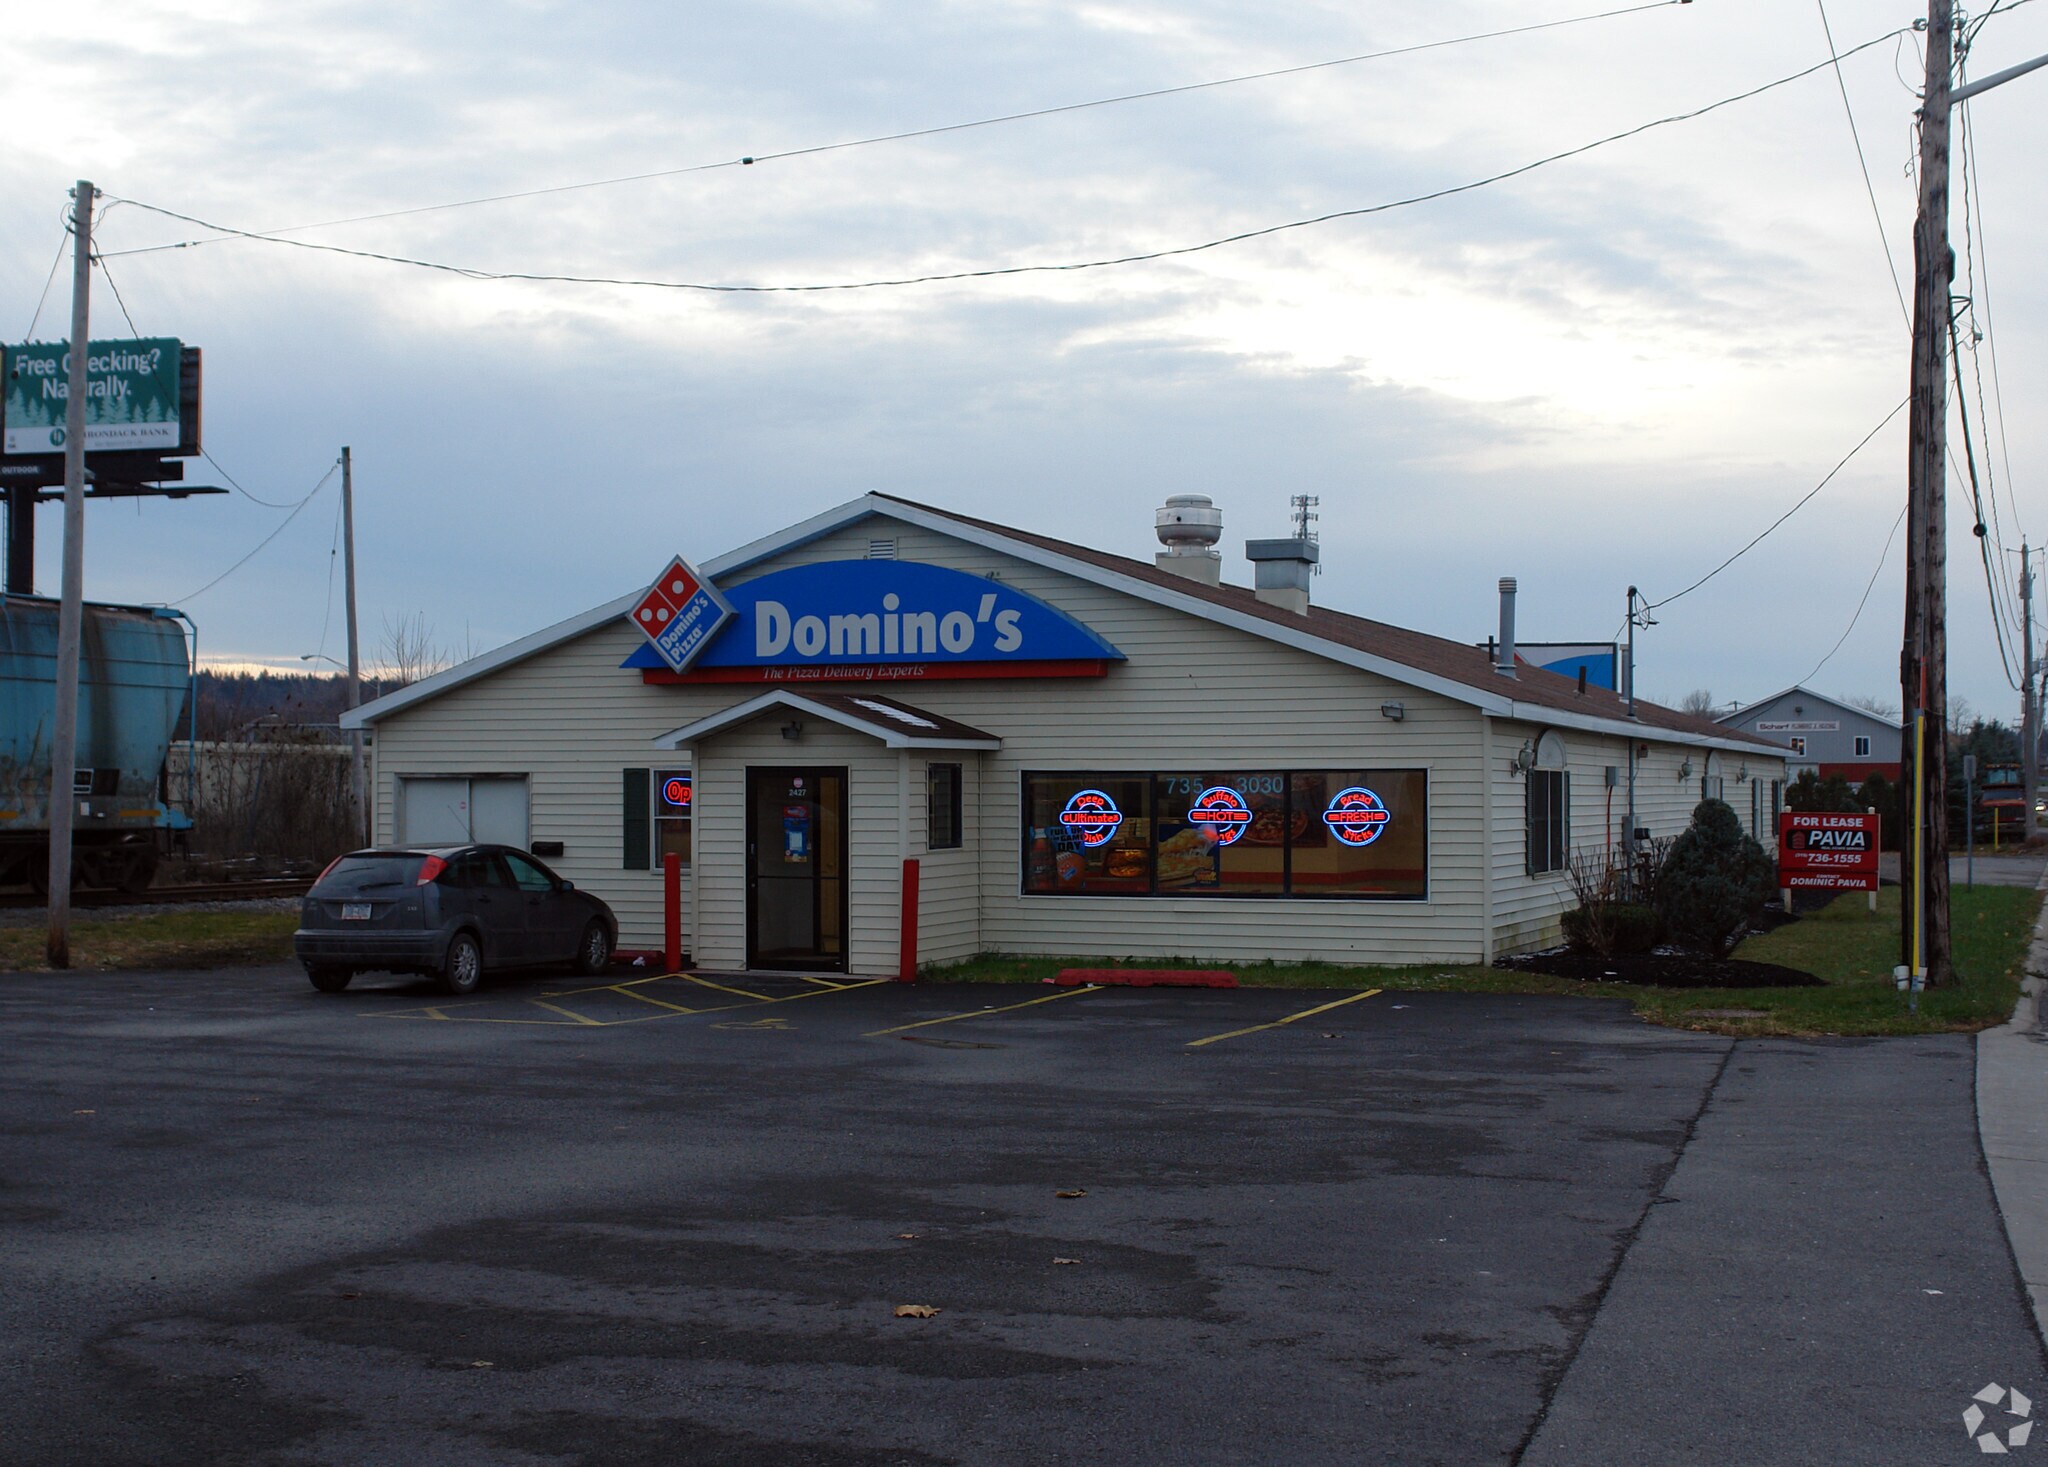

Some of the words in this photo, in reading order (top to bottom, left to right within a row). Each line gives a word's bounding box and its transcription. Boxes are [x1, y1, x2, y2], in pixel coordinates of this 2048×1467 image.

[16, 355, 56, 375] Free
[62, 348, 161, 375] Cecking?
[42, 374, 132, 400] Narally.
[140, 429, 169, 437] BANK
[1, 465, 40, 475] OUTDOOR
[660, 597, 709, 650] Domino's
[755, 593, 1023, 657] Domino's
[670, 627, 703, 662] Pizza
[762, 666, 784, 679] The
[787, 667, 820, 679] Pizza
[824, 664, 875, 680] Delivery
[877, 664, 925, 678] Experts
[1166, 778, 1204, 794] 735
[1236, 777, 1284, 794] 3030
[1076, 795, 1105, 808] Deep
[1201, 791, 1238, 807] Buffalo
[1340, 794, 1374, 807] Bread
[1069, 813, 1113, 823] Ultimate
[1206, 811, 1234, 821] HOT
[1340, 811, 1374, 823] FRESH
[1793, 816, 1819, 826] FOR
[1822, 817, 1864, 827] LEASE
[1343, 829, 1374, 842] Sticks
[1808, 830, 1865, 846] PAVIA
[1808, 853, 1862, 864] 736-1555
[1790, 877, 1835, 886] DOMINIC
[1837, 879, 1867, 887] PAVIA
